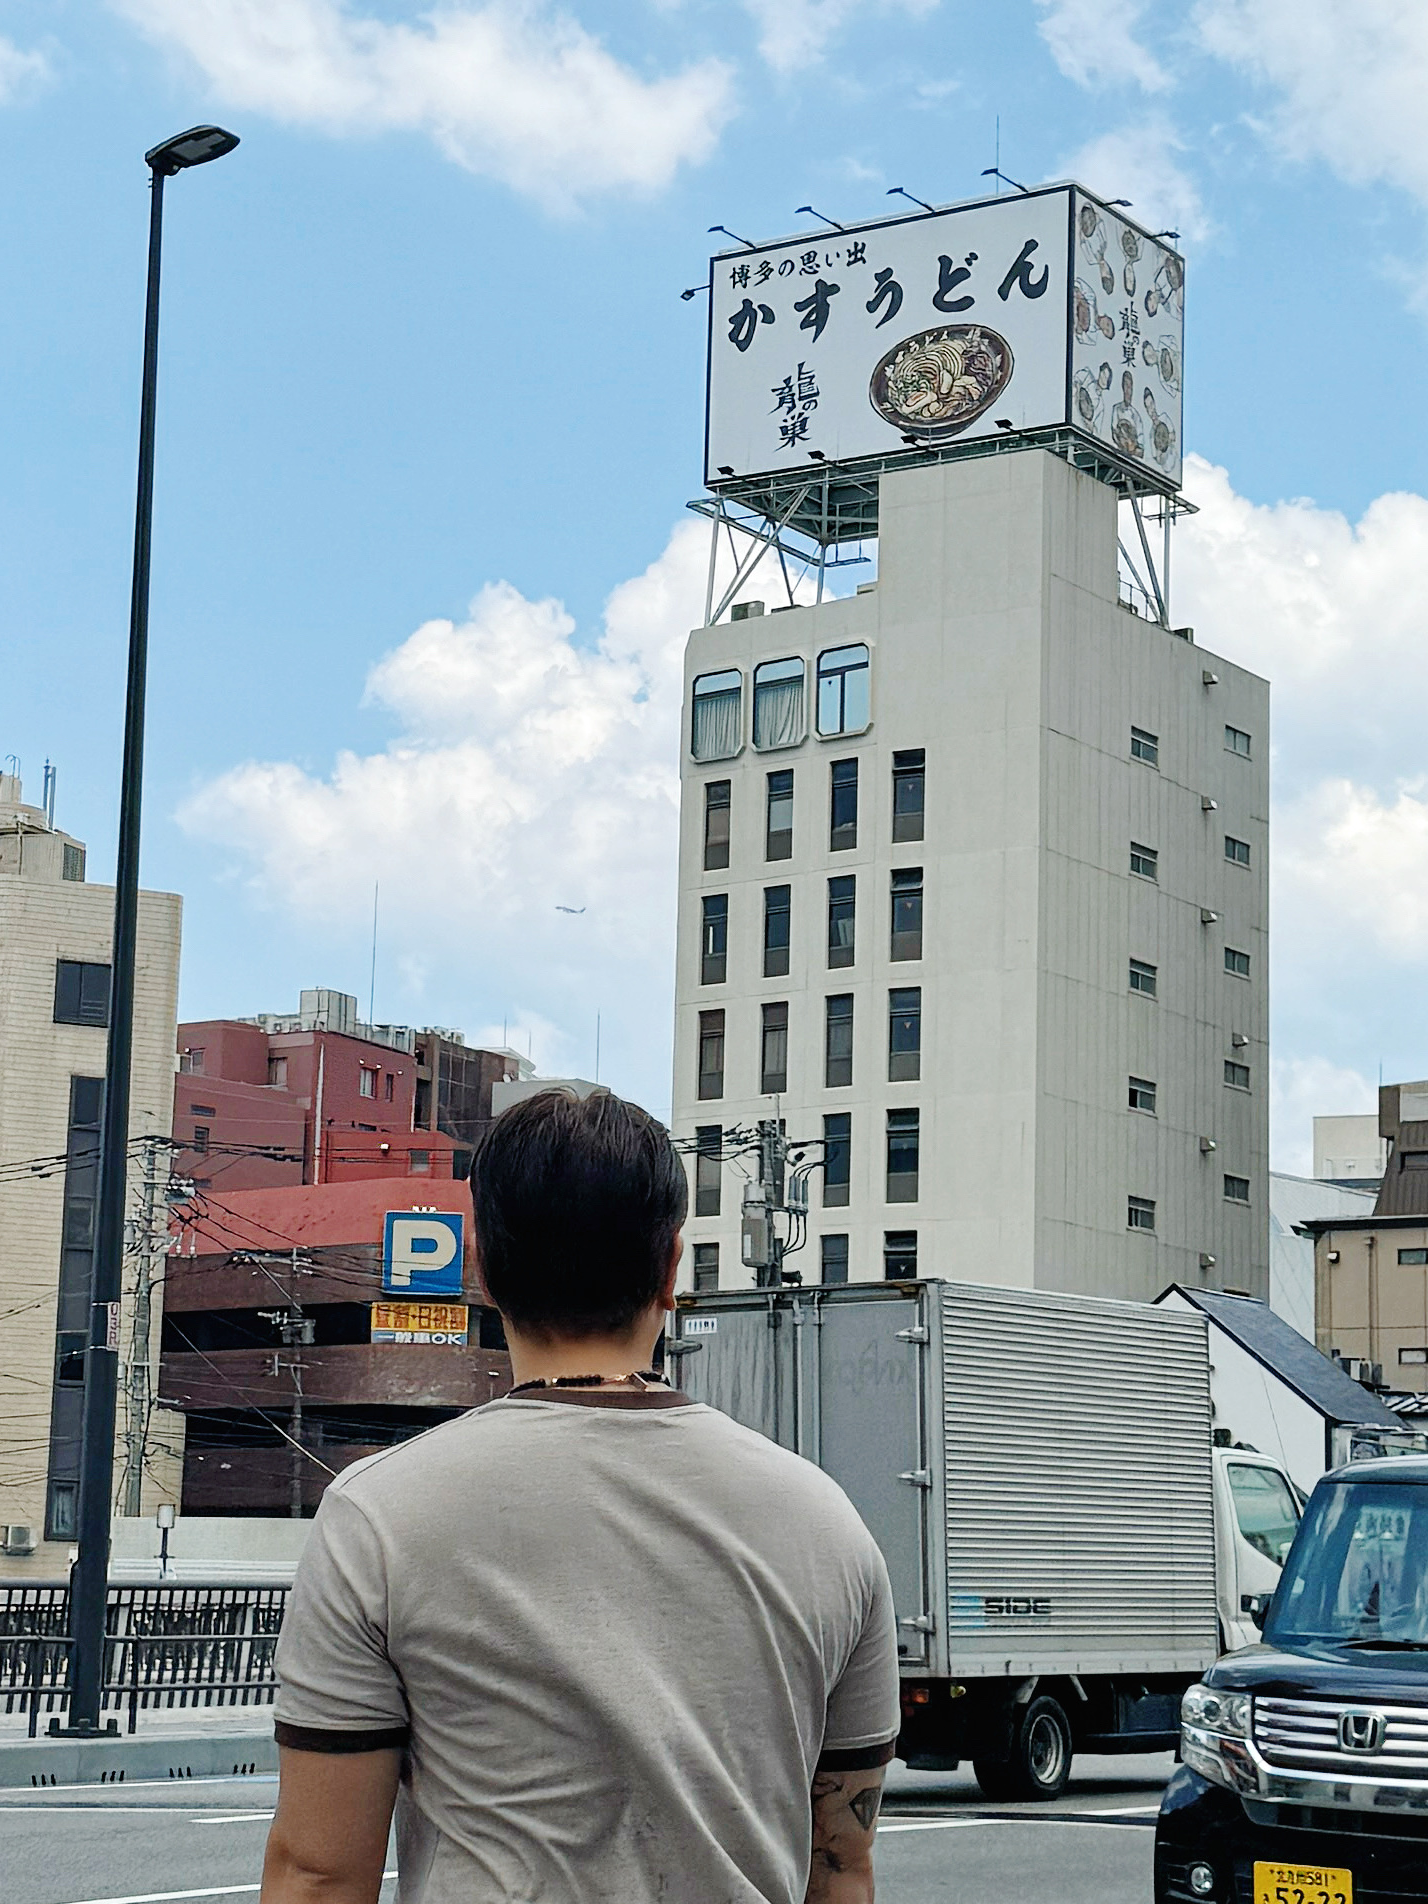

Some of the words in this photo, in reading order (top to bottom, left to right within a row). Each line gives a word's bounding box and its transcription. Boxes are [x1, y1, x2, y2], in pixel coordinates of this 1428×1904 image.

[728, 238, 1050, 353] かすうどん
[729, 241, 867, 289] 博多の思い出
[391, 1219, 457, 1286] P
